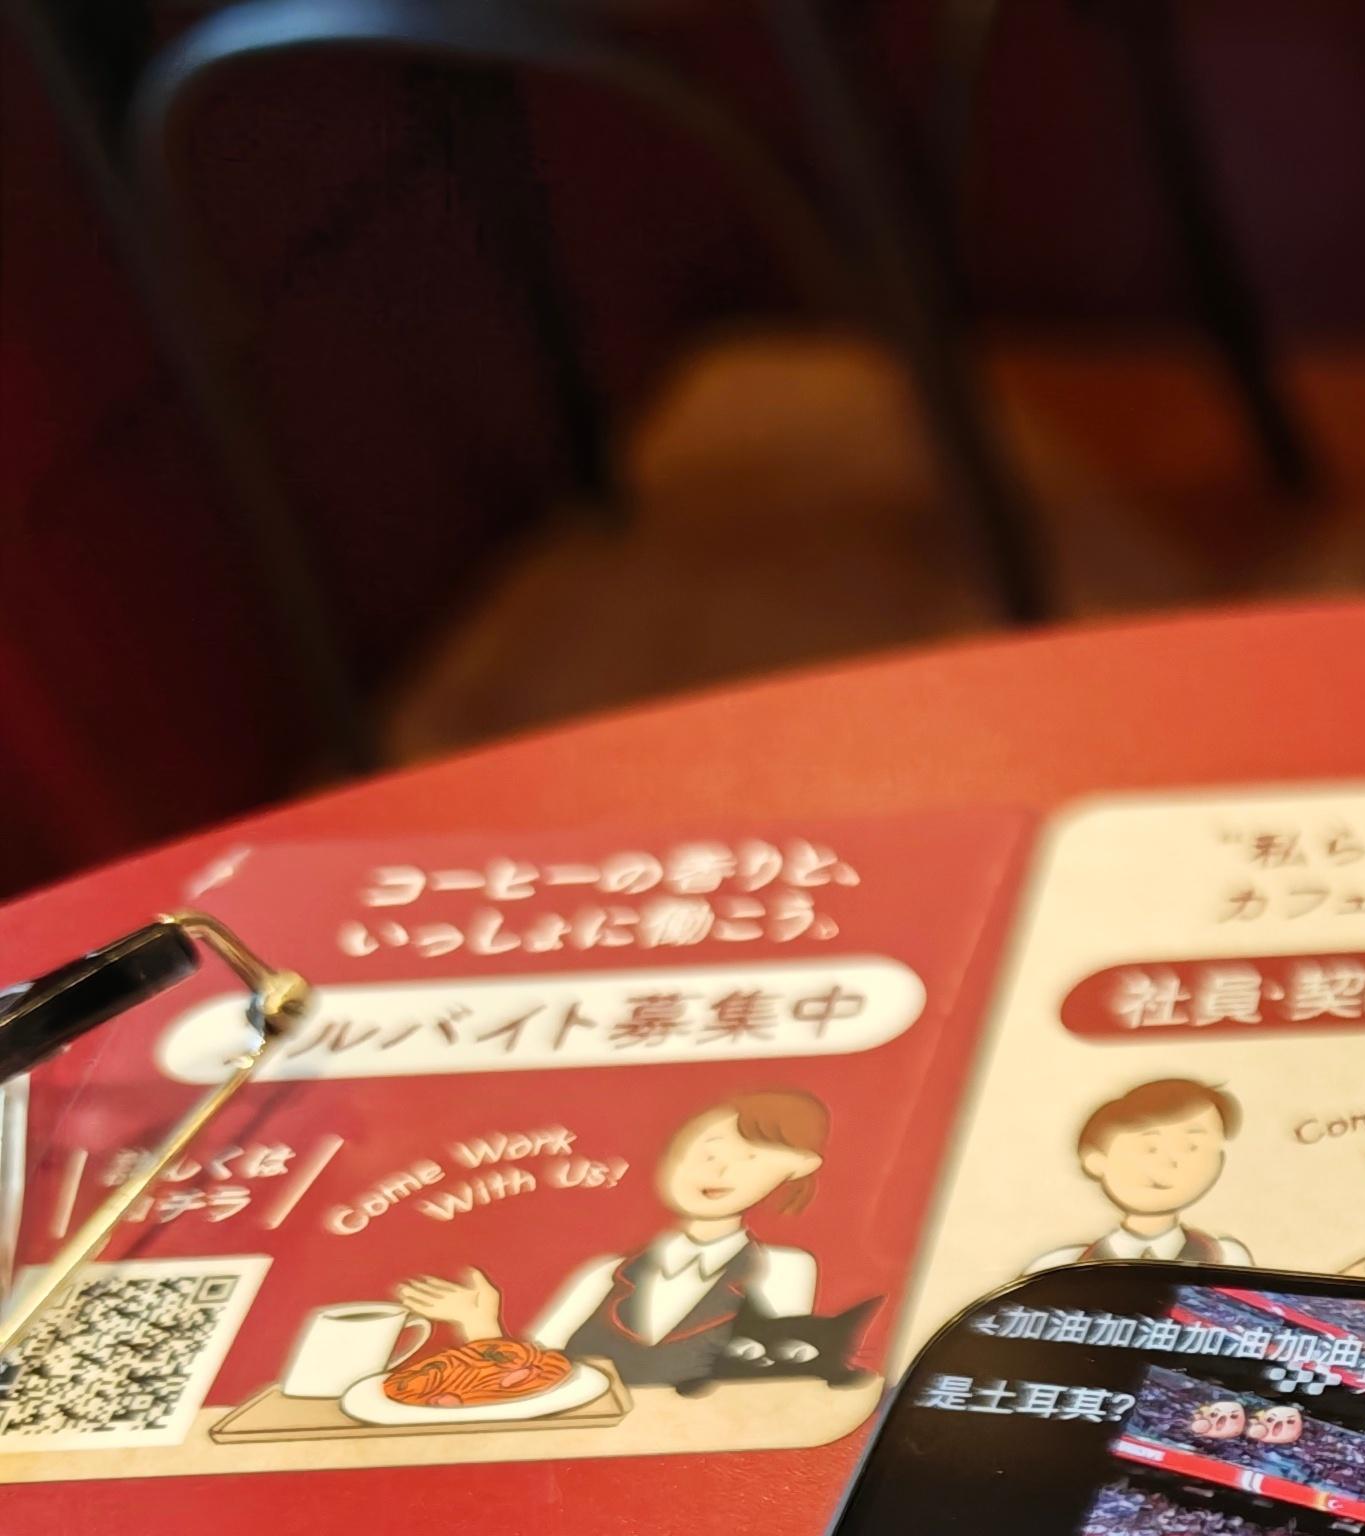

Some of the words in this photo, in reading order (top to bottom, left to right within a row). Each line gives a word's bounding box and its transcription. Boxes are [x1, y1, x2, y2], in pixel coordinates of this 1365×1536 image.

[225, 984, 868, 1065] ルバイト募集中
[323, 1159, 446, 1236] Come
[450, 1124, 577, 1168] Work
[416, 1165, 536, 1221] With
[549, 1154, 630, 1188] Us!
